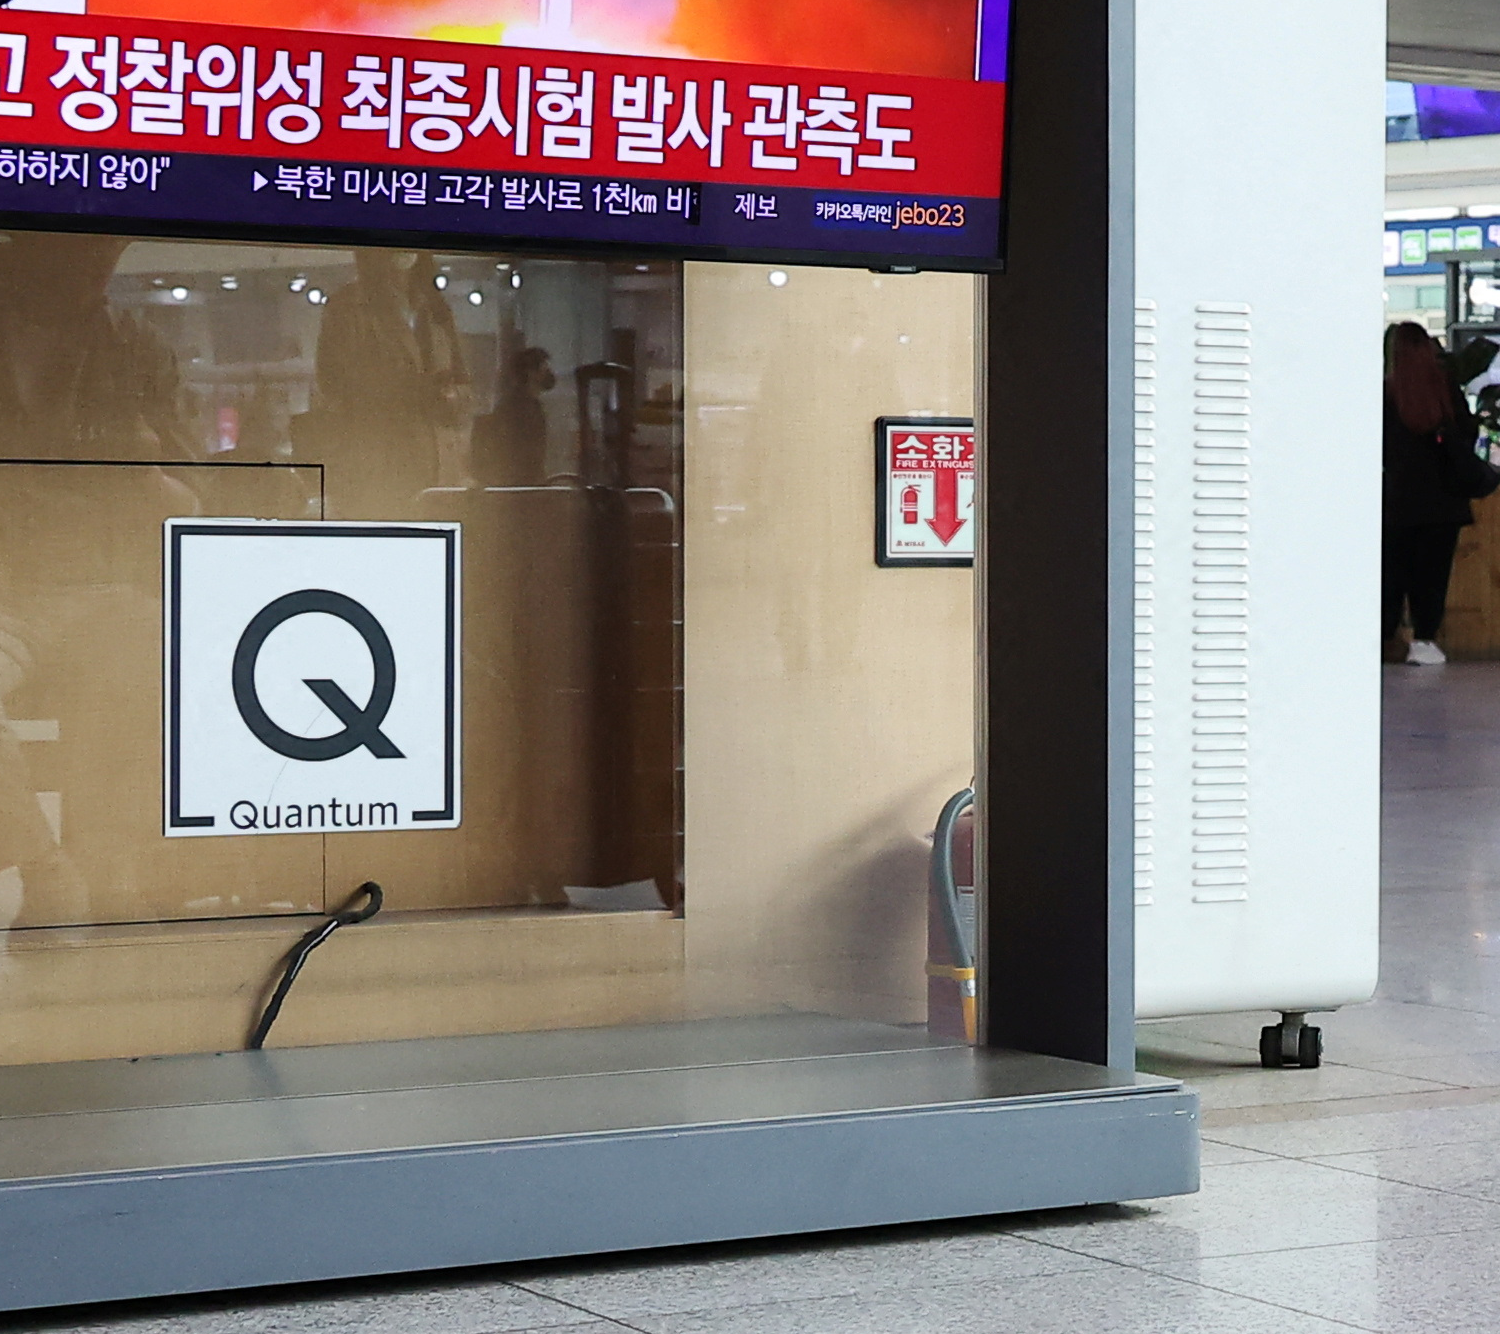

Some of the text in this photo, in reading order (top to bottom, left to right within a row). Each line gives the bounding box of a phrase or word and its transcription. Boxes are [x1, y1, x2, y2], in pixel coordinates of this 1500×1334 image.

[49, 33, 324, 145] 정찰위성
[340, 54, 595, 160] 최종시험
[611, 73, 732, 169] 발사
[743, 82, 917, 177] 관측도
[274, 164, 699, 221] 북한 미사일 고각 발사로 1천km 비
[734, 192, 779, 223] 제보
[892, 200, 966, 231] jebo23
[895, 459, 919, 469] FIRE
[229, 796, 399, 830] Quantum
